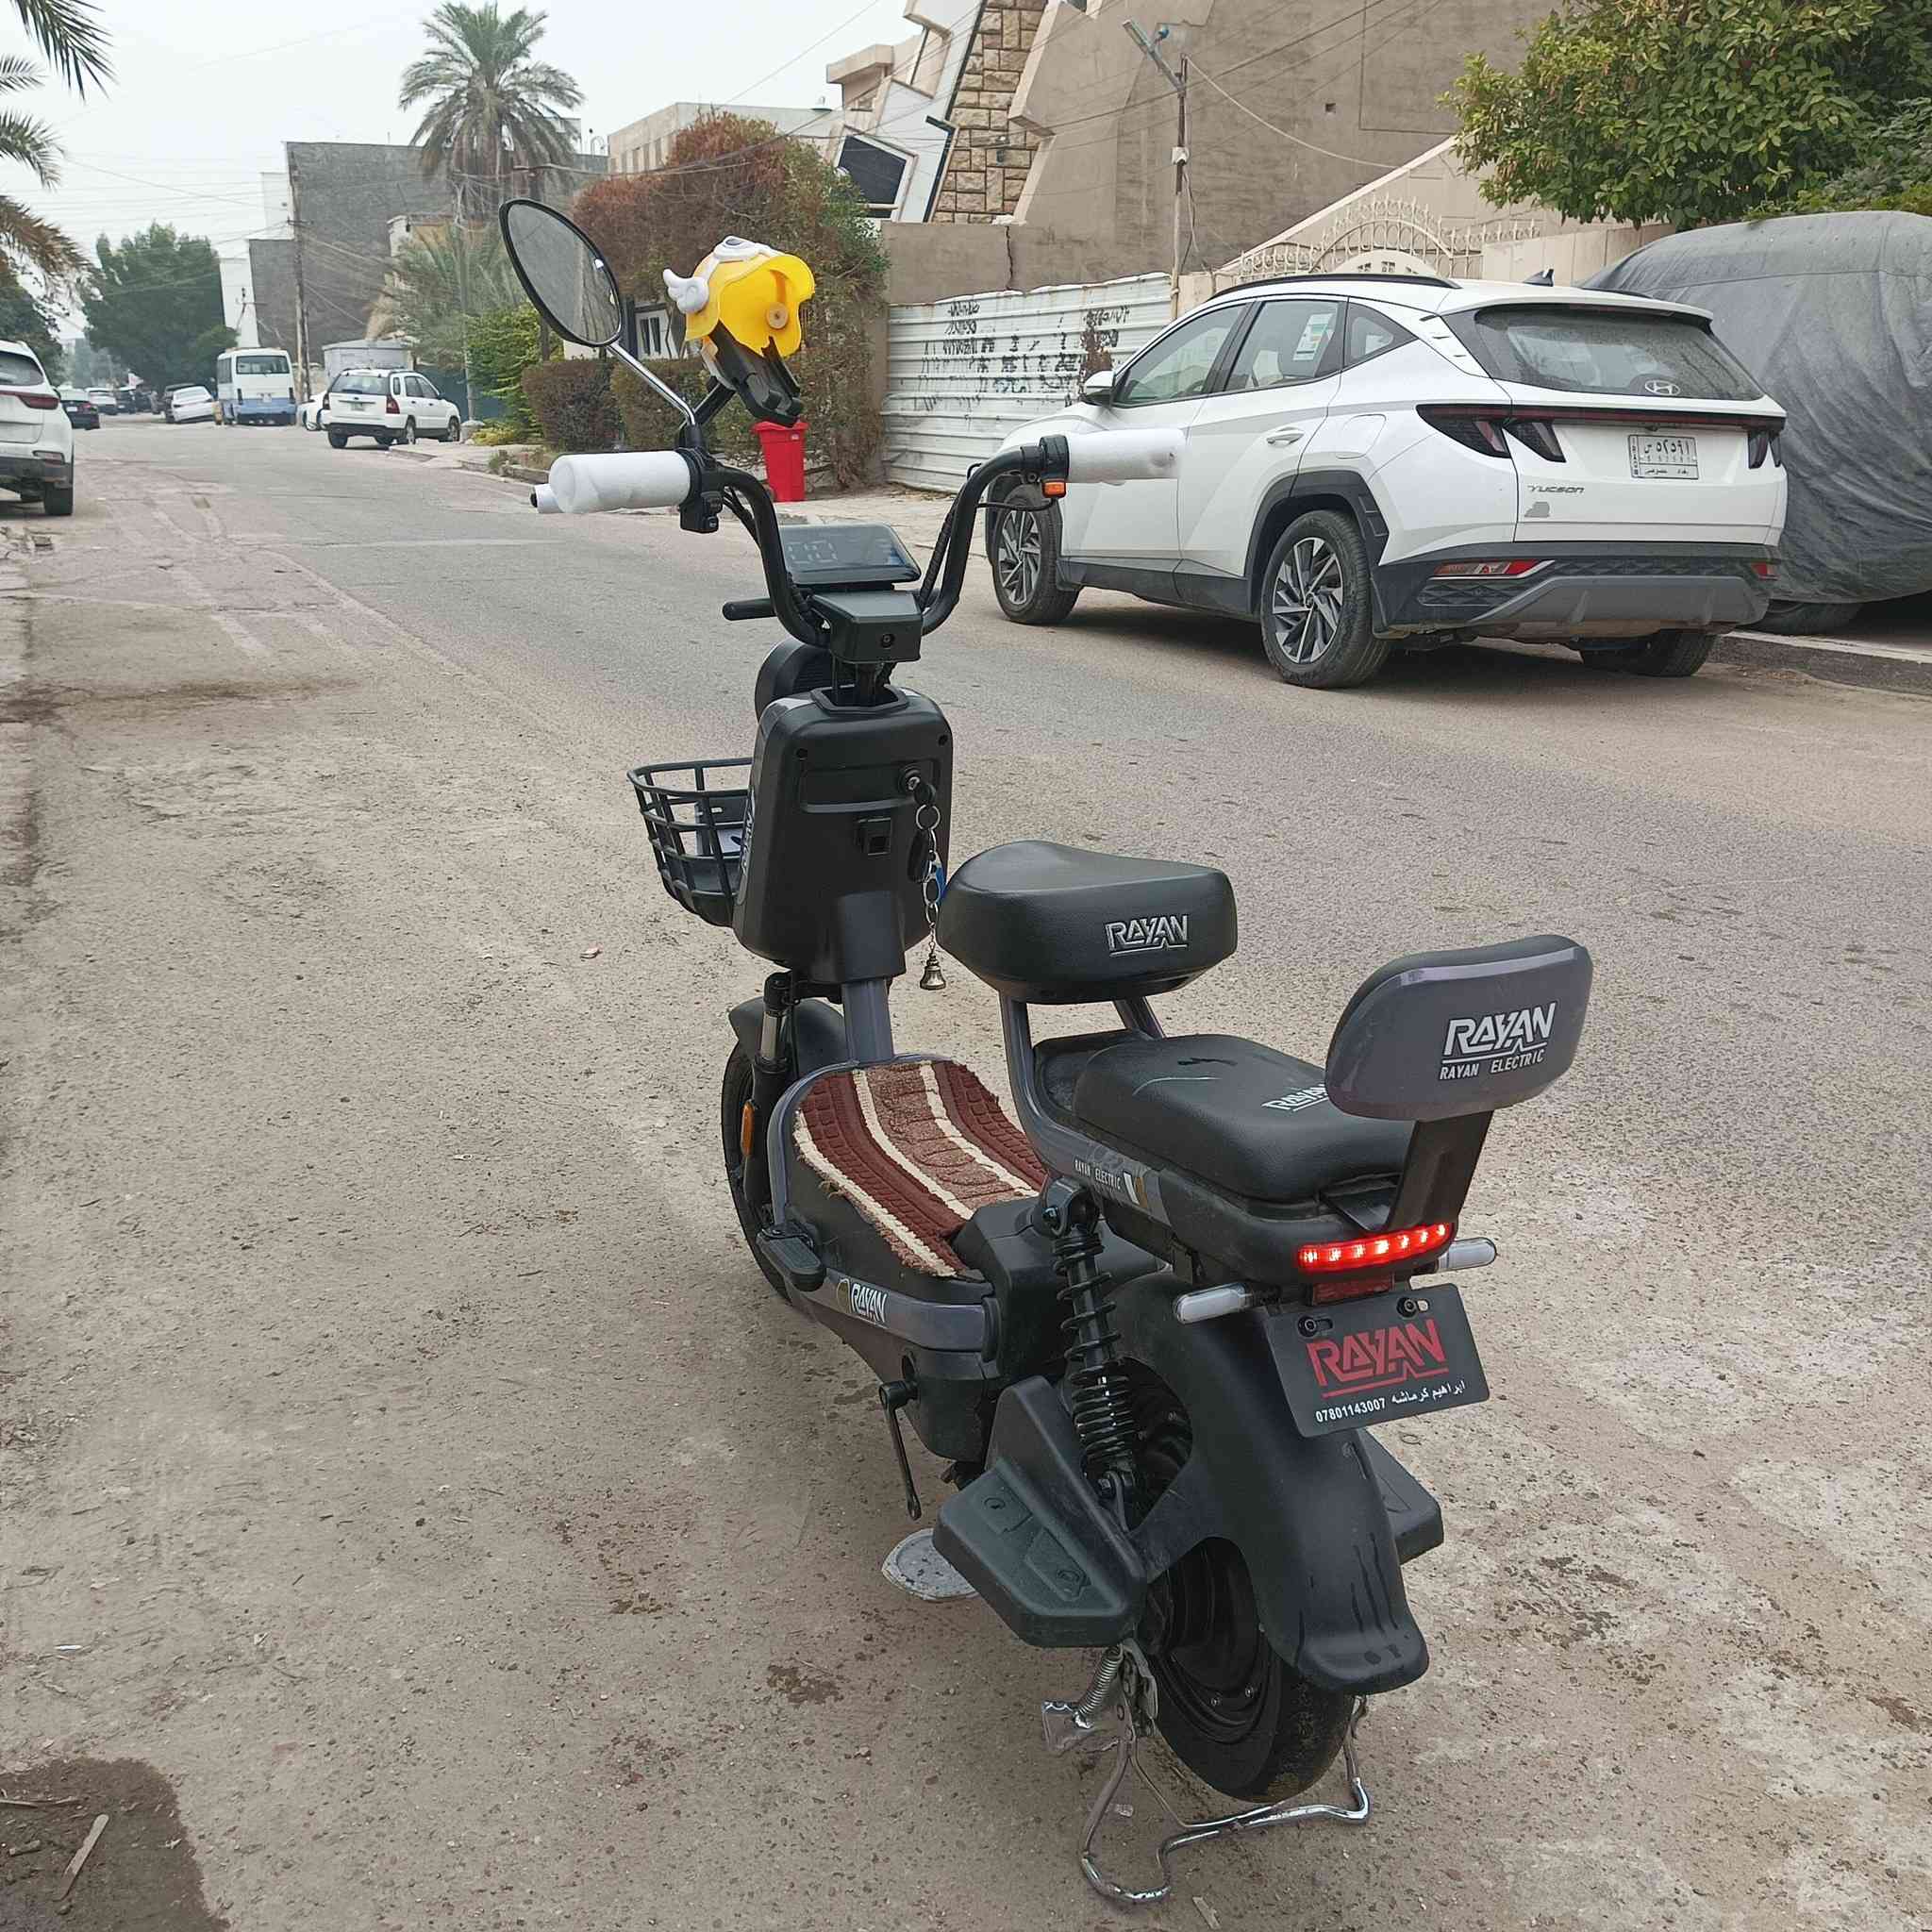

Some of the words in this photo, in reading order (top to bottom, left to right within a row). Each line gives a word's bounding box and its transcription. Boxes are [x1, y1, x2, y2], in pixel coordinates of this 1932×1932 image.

[1106, 915, 1189, 950] RAYAN
[1443, 1002, 1557, 1057] RAYAN
[1440, 1063, 1480, 1080] RAYAN
[1490, 1048, 1545, 1074] ELECTRIC
[851, 1283, 888, 1323] RAYAN
[1306, 1319, 1446, 1387] RAYAN
[1315, 1398, 1386, 1423] 07801143007
